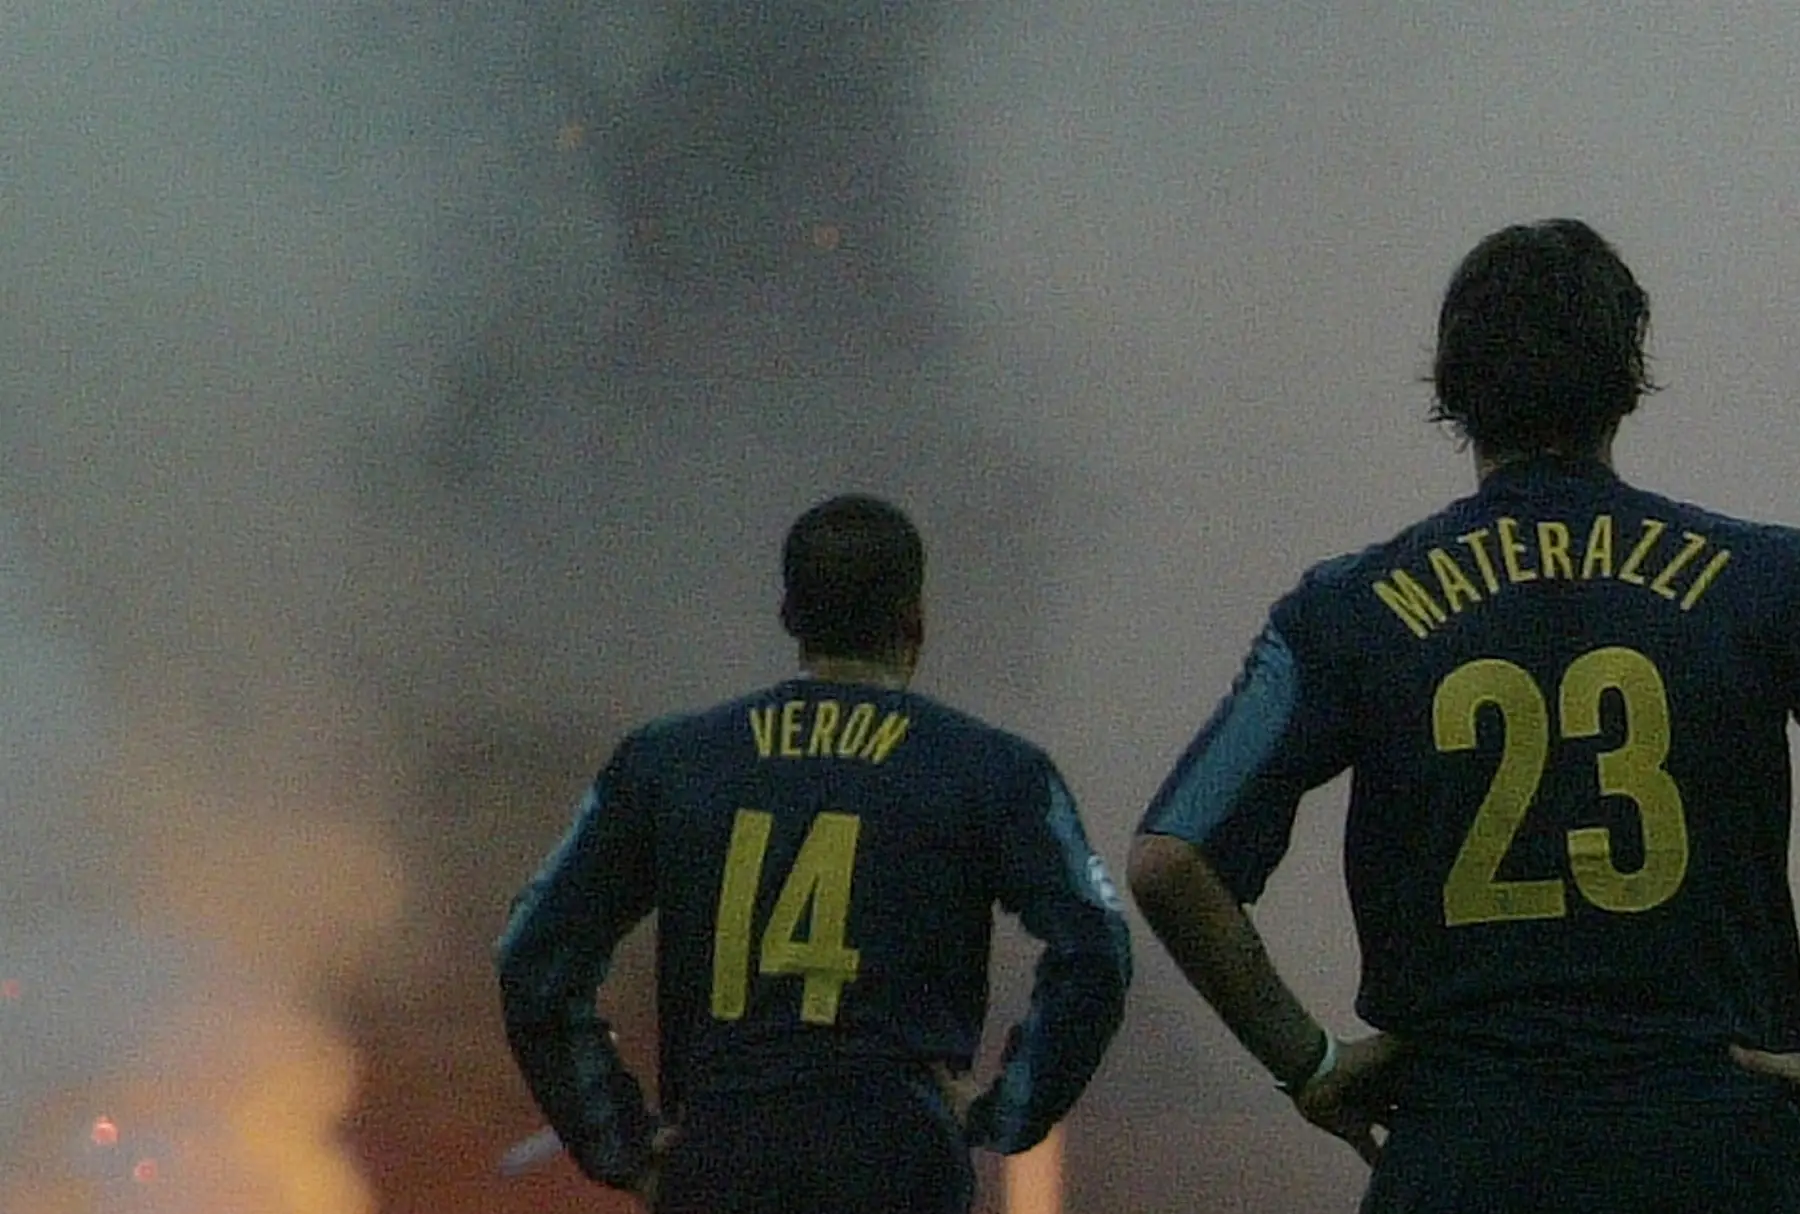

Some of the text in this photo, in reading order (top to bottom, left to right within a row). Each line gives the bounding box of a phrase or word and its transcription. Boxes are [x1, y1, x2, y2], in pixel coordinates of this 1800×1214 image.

[1372, 514, 1732, 640] MATERAZZI
[749, 699, 910, 765] VERON
[1431, 645, 1690, 928] 23
[710, 807, 862, 1026] 14
